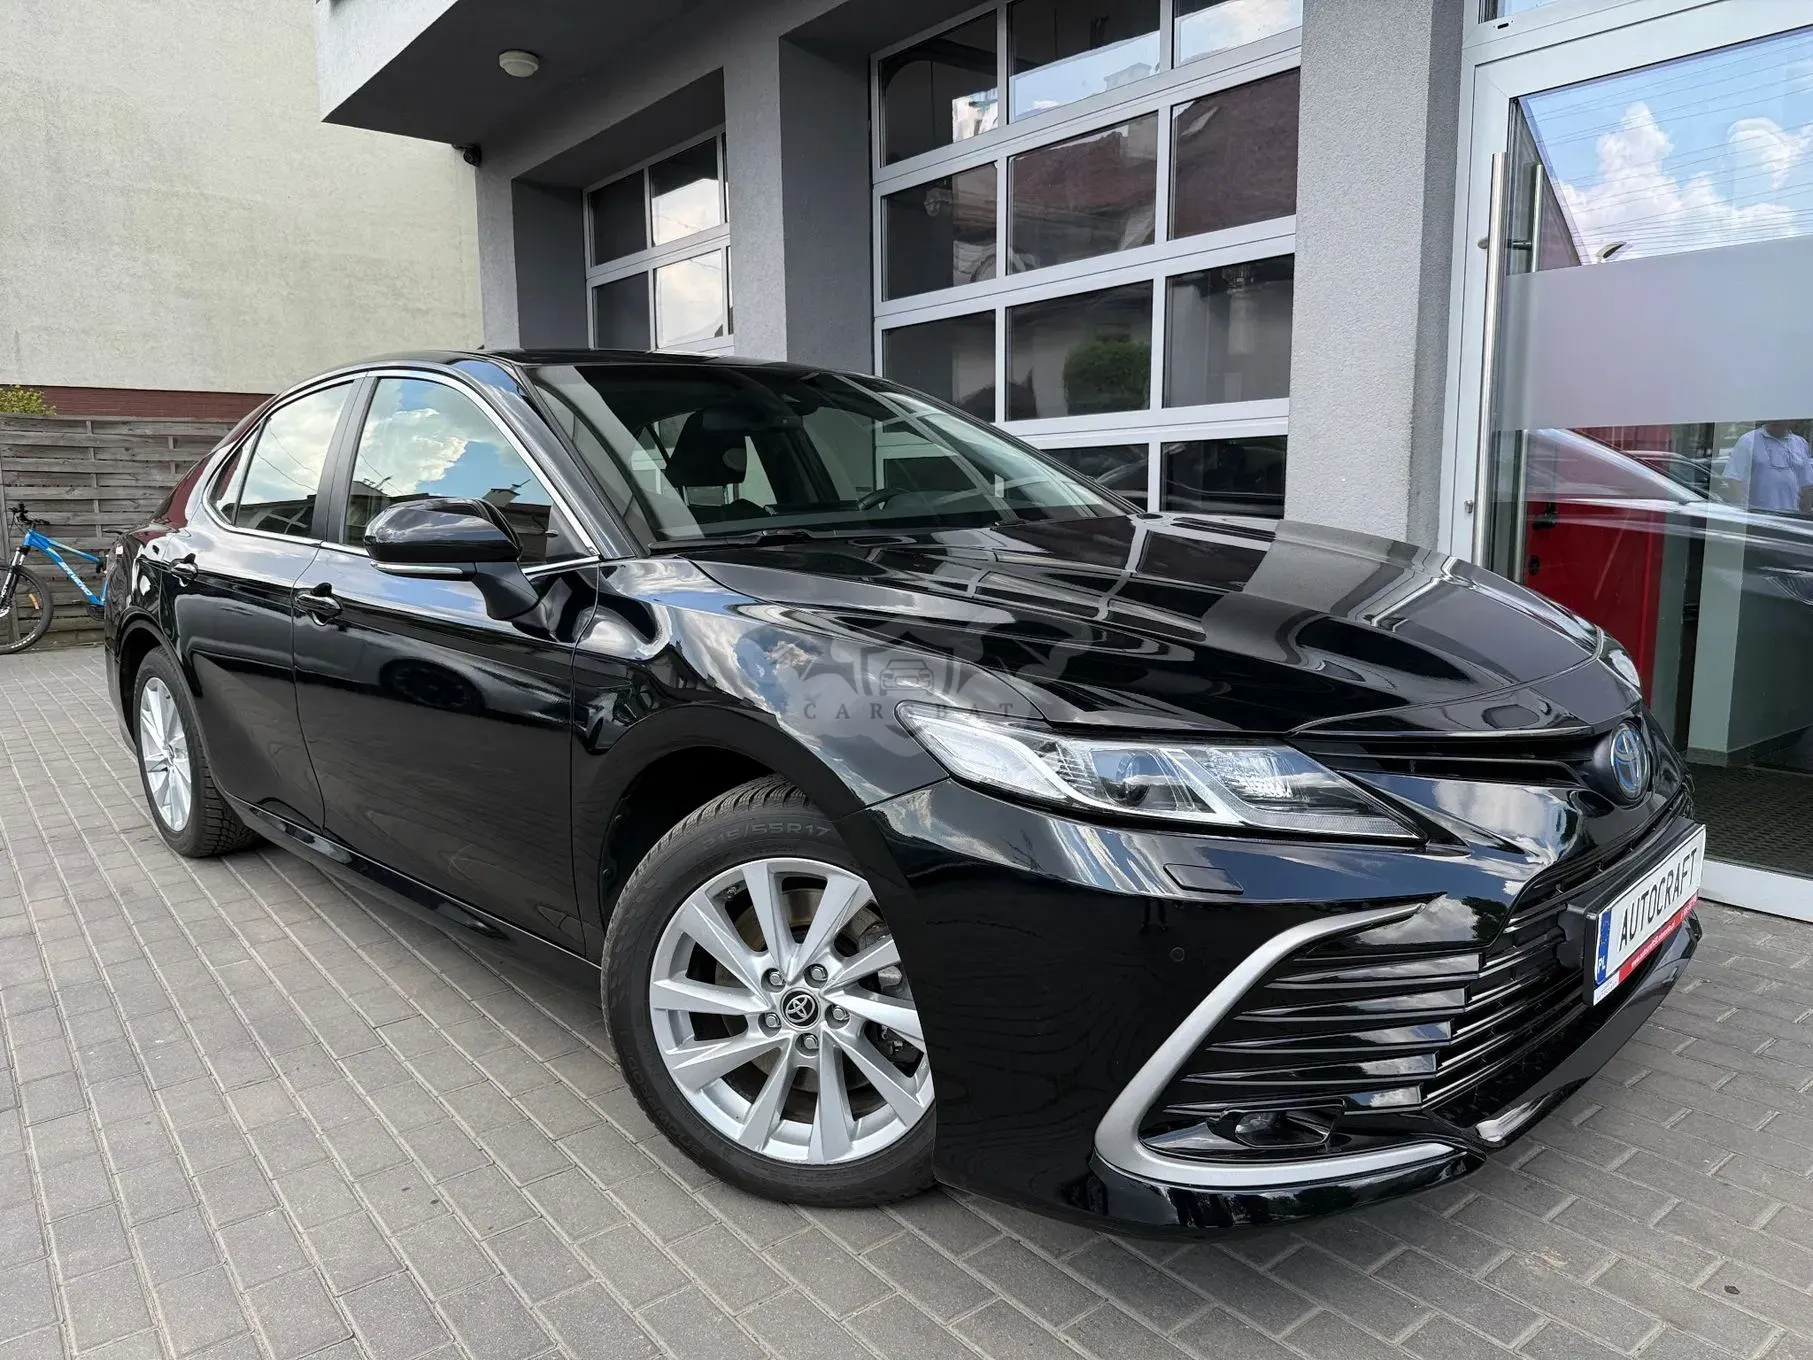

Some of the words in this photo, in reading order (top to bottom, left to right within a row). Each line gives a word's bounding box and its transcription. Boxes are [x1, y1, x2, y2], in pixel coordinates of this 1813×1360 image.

[701, 822, 832, 850] 215/55R17
[1618, 847, 1697, 953] AUTOCRAFT
[1597, 957, 1606, 974] PL
